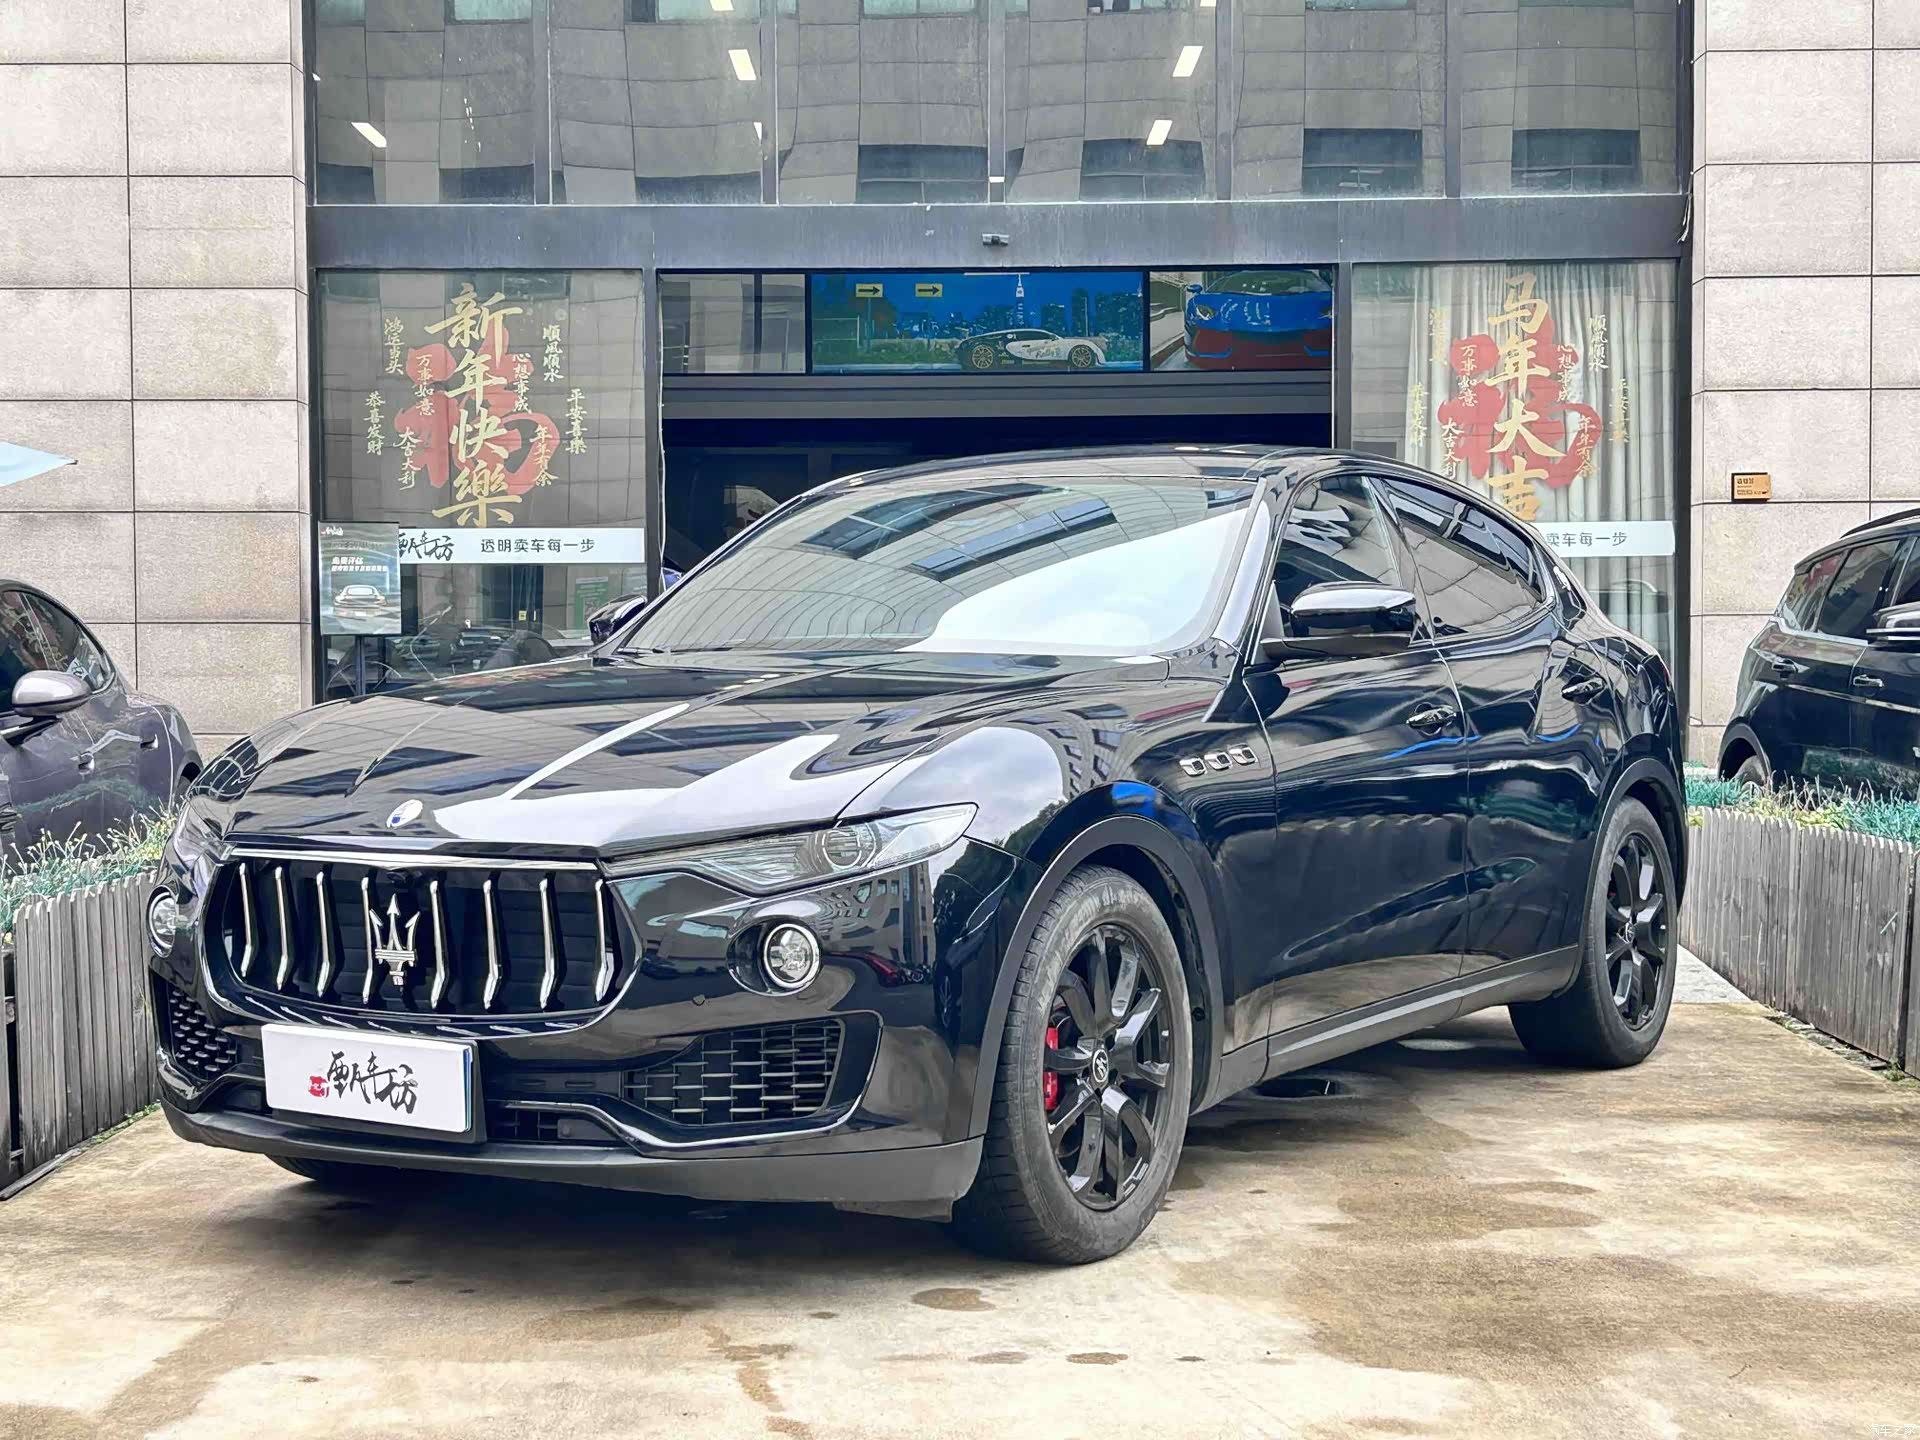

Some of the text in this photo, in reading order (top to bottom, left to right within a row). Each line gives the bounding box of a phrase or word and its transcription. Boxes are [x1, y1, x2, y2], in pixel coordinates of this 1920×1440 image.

[414, 353, 435, 417] 万事如意
[424, 282, 523, 528] 新年快樂
[511, 352, 533, 415] 心想事成
[1457, 343, 1479, 408] 万事如意
[1485, 273, 1566, 521] 马年大吉
[392, 426, 423, 491] 大吉大利
[529, 423, 560, 488] 年年有余
[1440, 416, 1465, 481] 大吉大利
[480, 537, 596, 554] 透明卖车每一步
[1546, 531, 1628, 548] 卖车每一步
